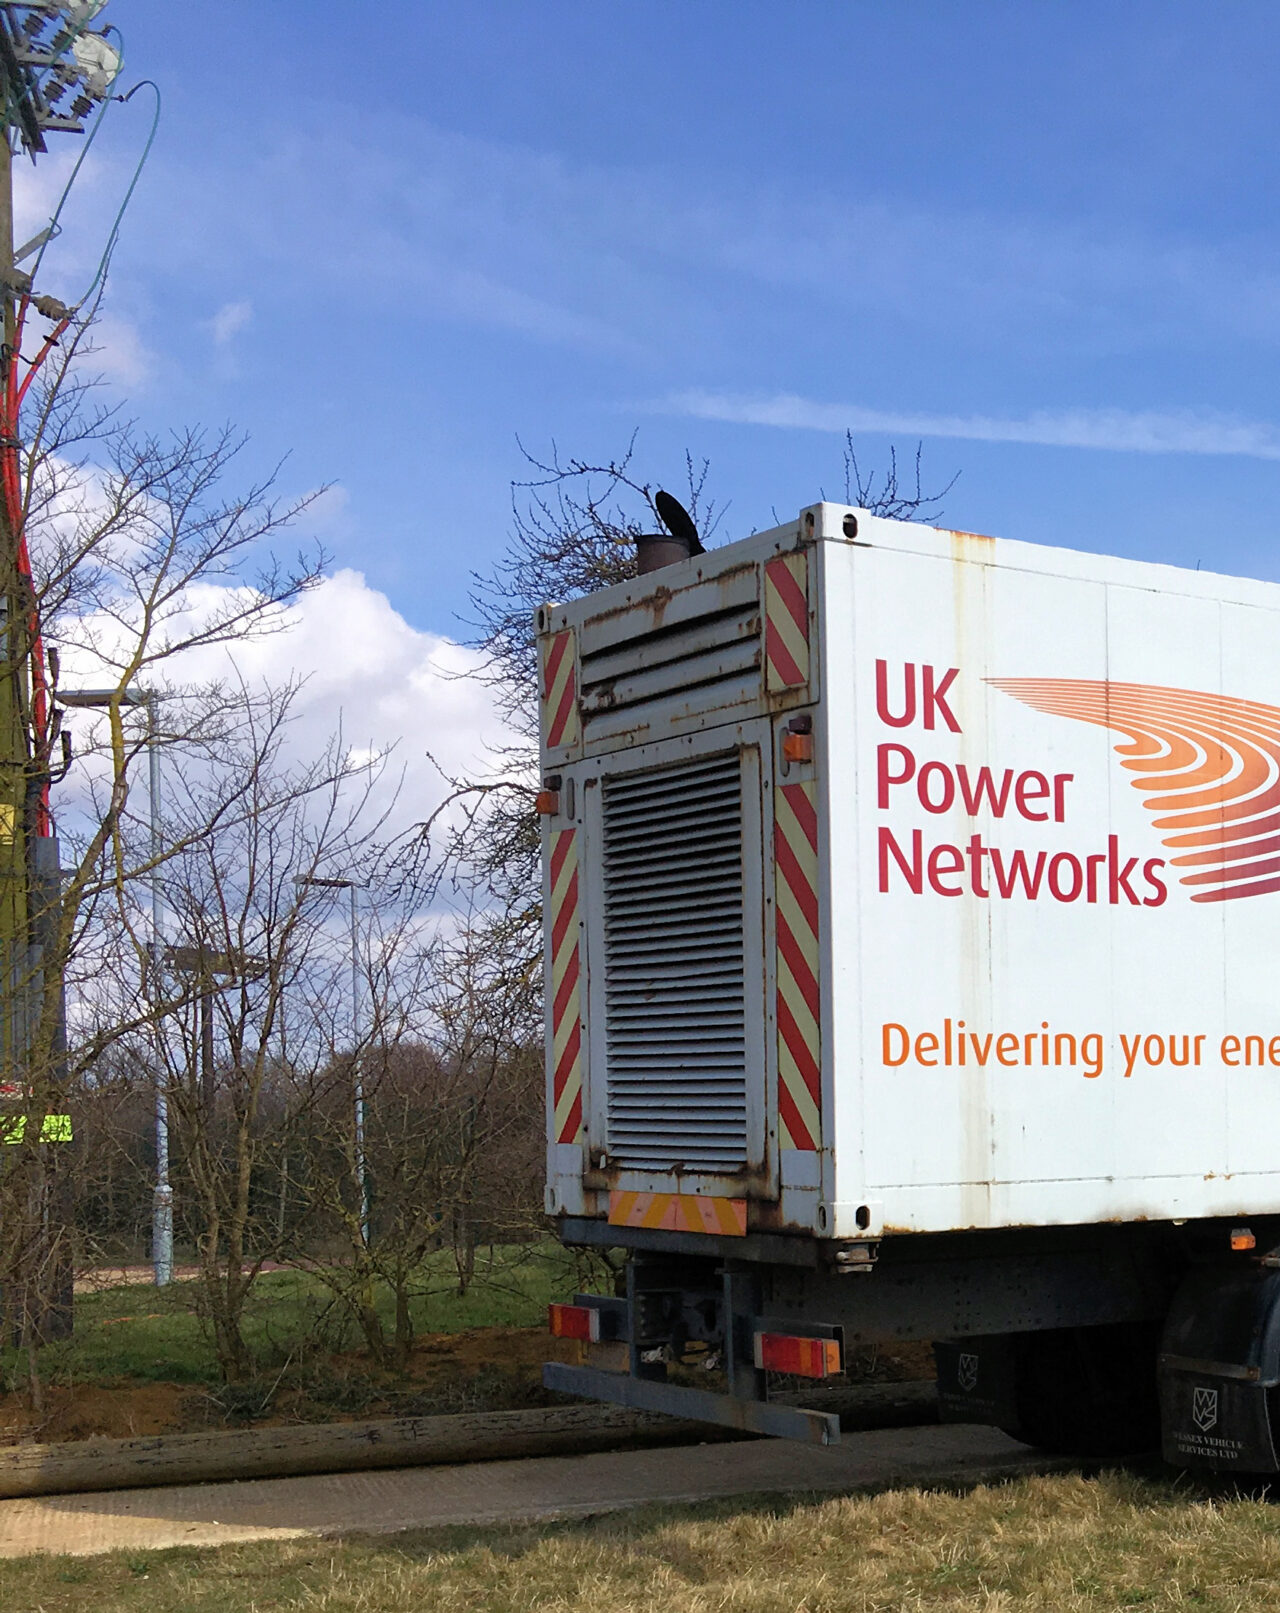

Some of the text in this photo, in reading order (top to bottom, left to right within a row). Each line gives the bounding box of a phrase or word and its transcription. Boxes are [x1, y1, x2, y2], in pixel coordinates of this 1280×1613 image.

[876, 659, 962, 733] UK
[877, 743, 1074, 823] Power
[878, 826, 1168, 907] Networks
[881, 1018, 1104, 1079] Delivering
[1118, 1033, 1206, 1078] your
[1218, 1449, 1239, 1459] LTD
